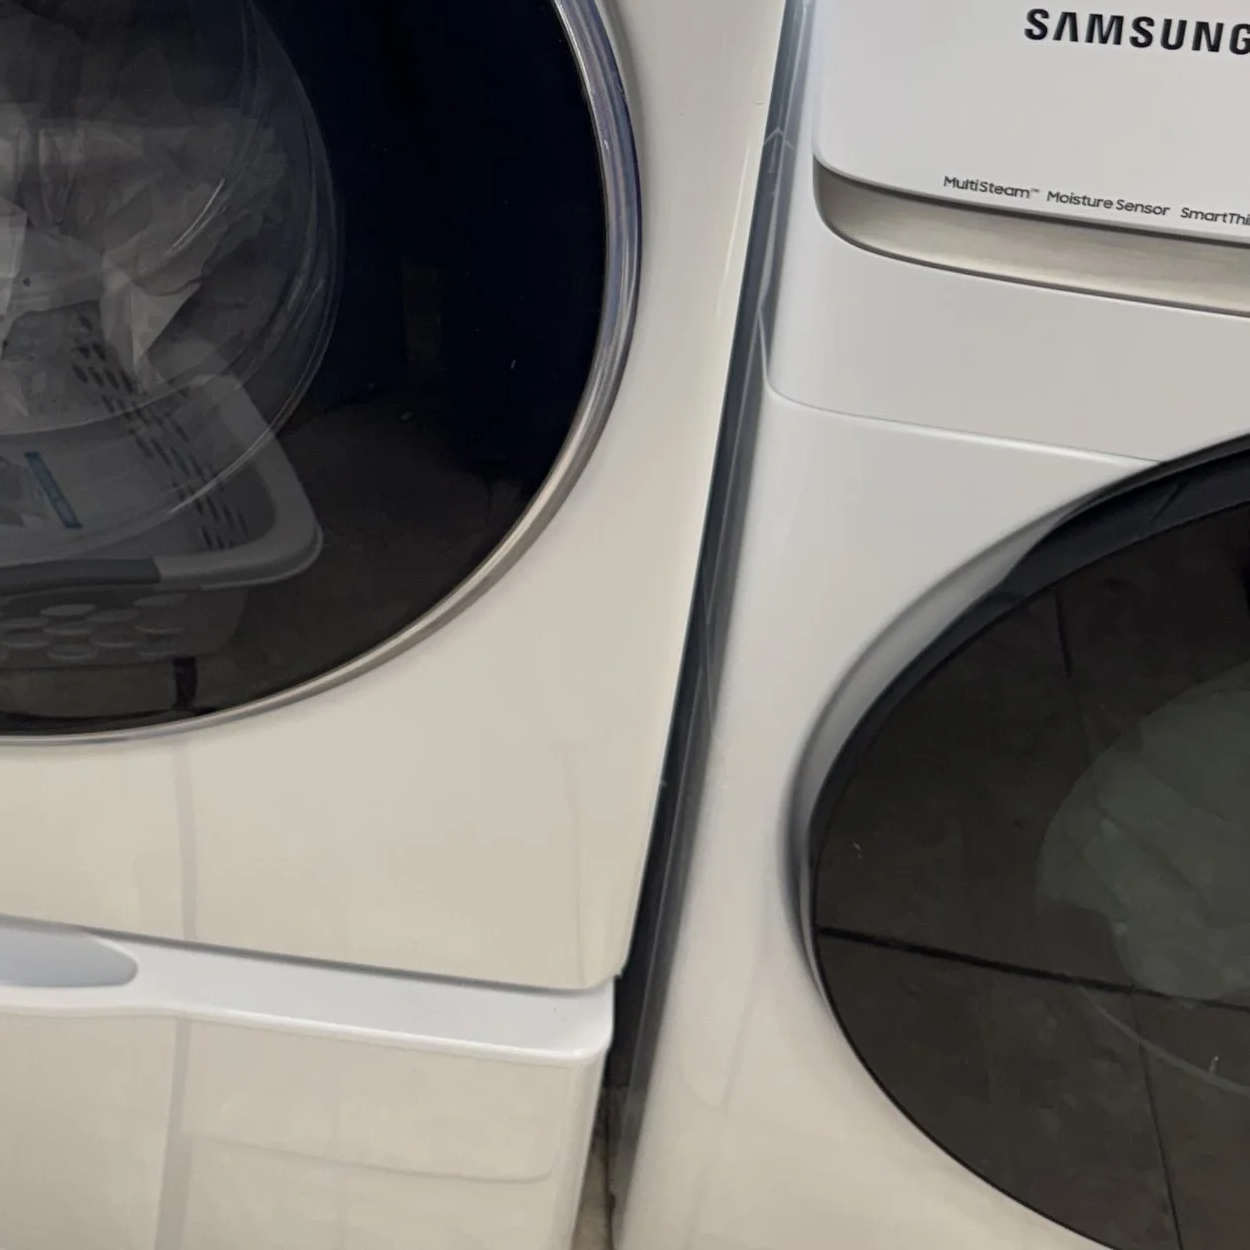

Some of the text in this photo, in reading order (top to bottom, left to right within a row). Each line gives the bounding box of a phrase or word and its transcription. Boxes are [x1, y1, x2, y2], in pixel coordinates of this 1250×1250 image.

[1024, 8, 1250, 55] SAMSUNG
[1047, 191, 1113, 210] Moisture
[1116, 199, 1170, 217] Sensor
